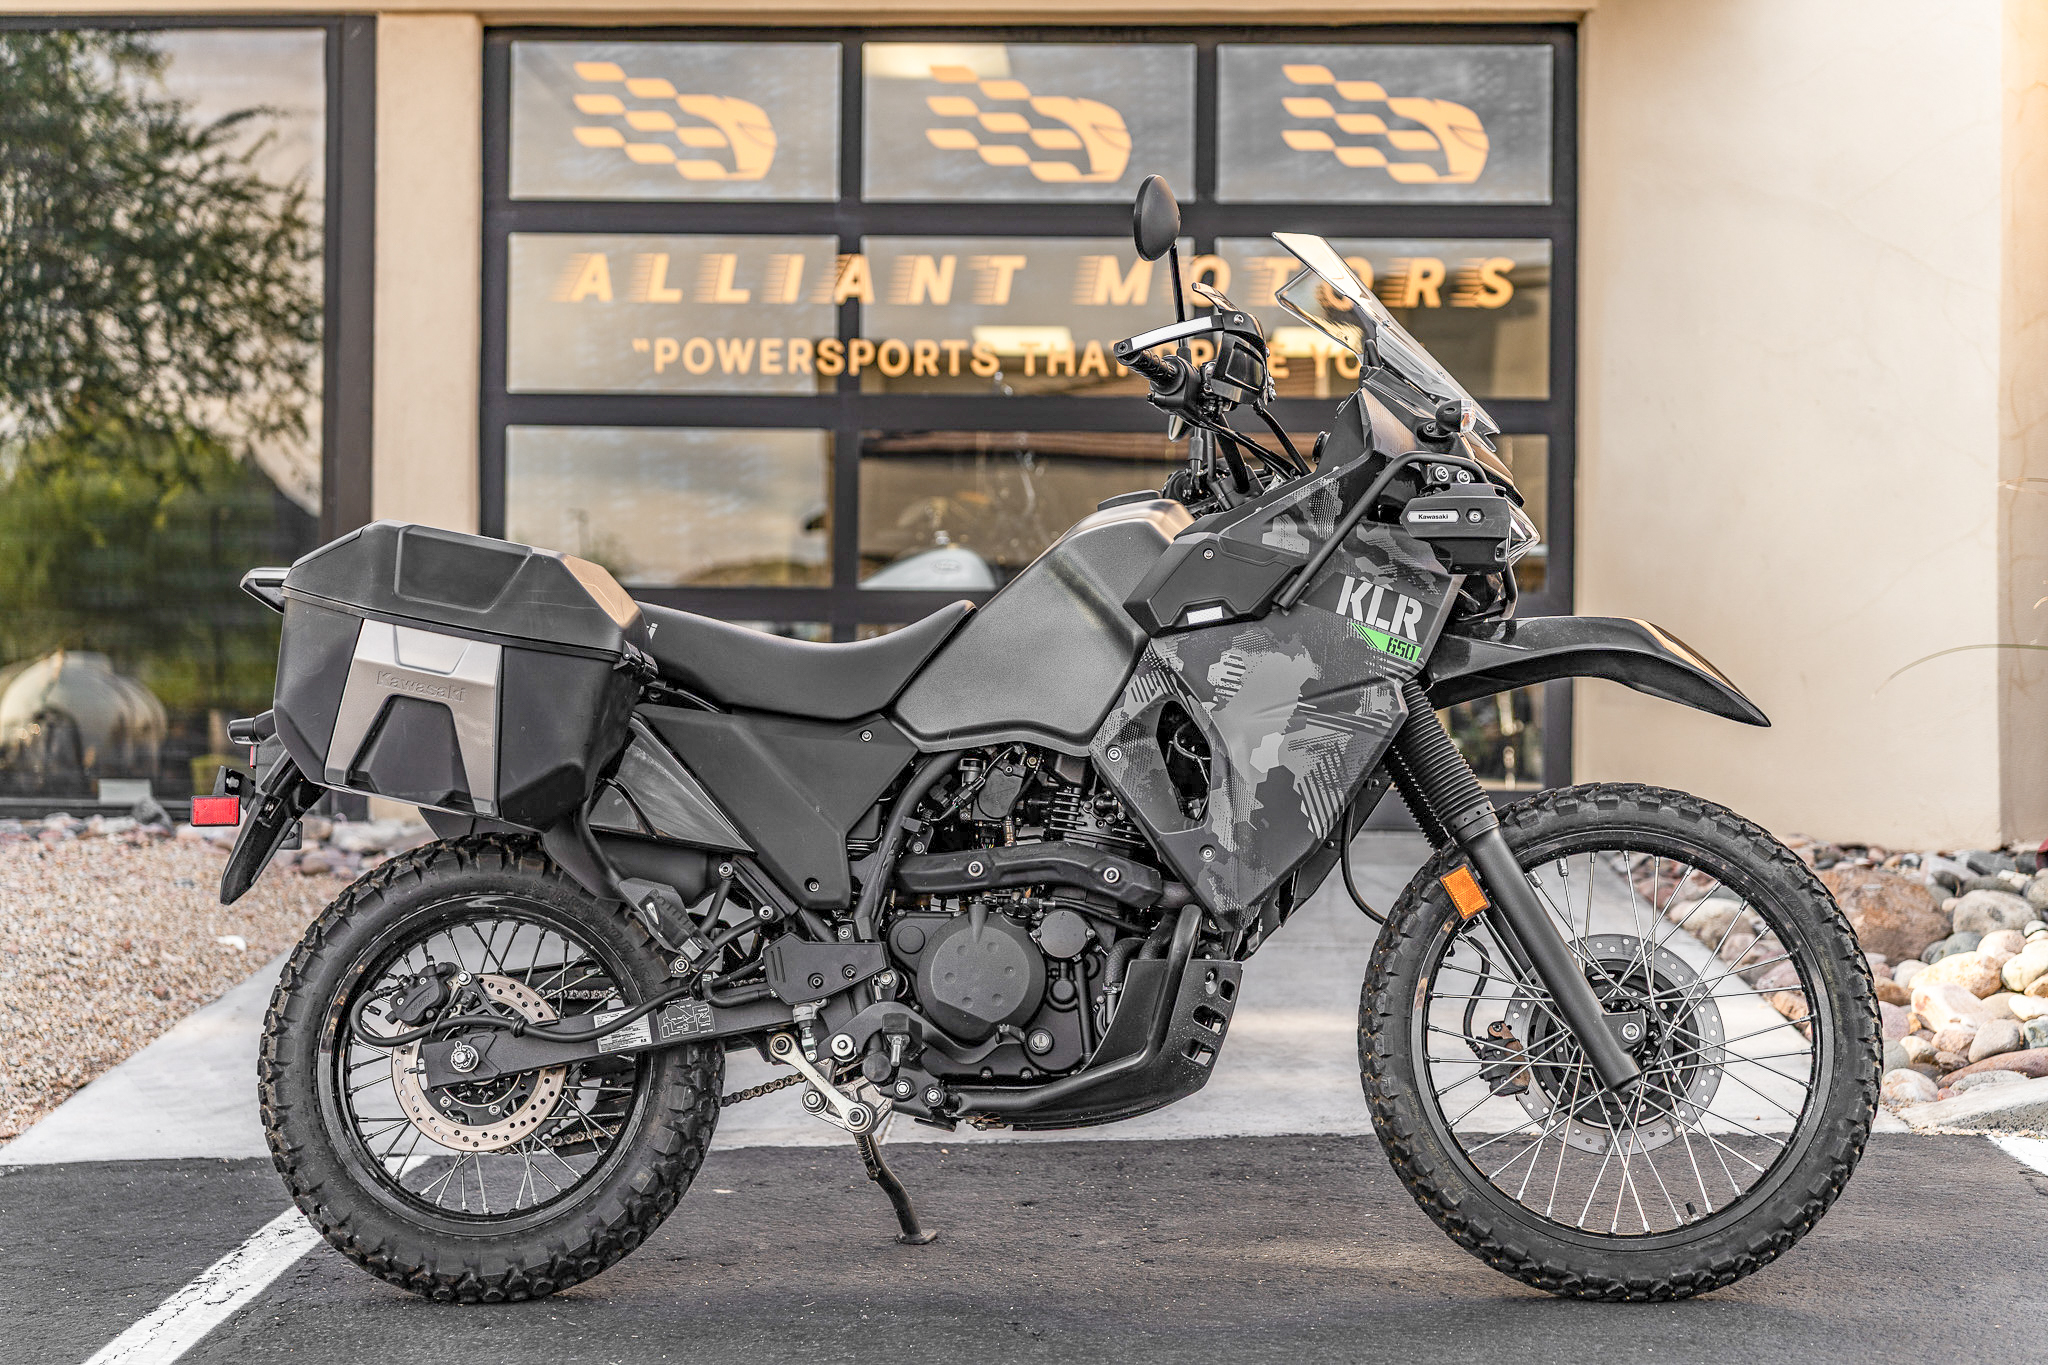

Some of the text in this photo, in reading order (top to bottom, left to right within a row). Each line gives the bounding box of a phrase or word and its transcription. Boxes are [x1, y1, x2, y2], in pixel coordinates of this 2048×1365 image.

[555, 253, 1027, 306] ALLIANT
[1335, 575, 1423, 642] KLR
[1385, 636, 1416, 661] 650
[376, 670, 466, 702] Kawasaki
